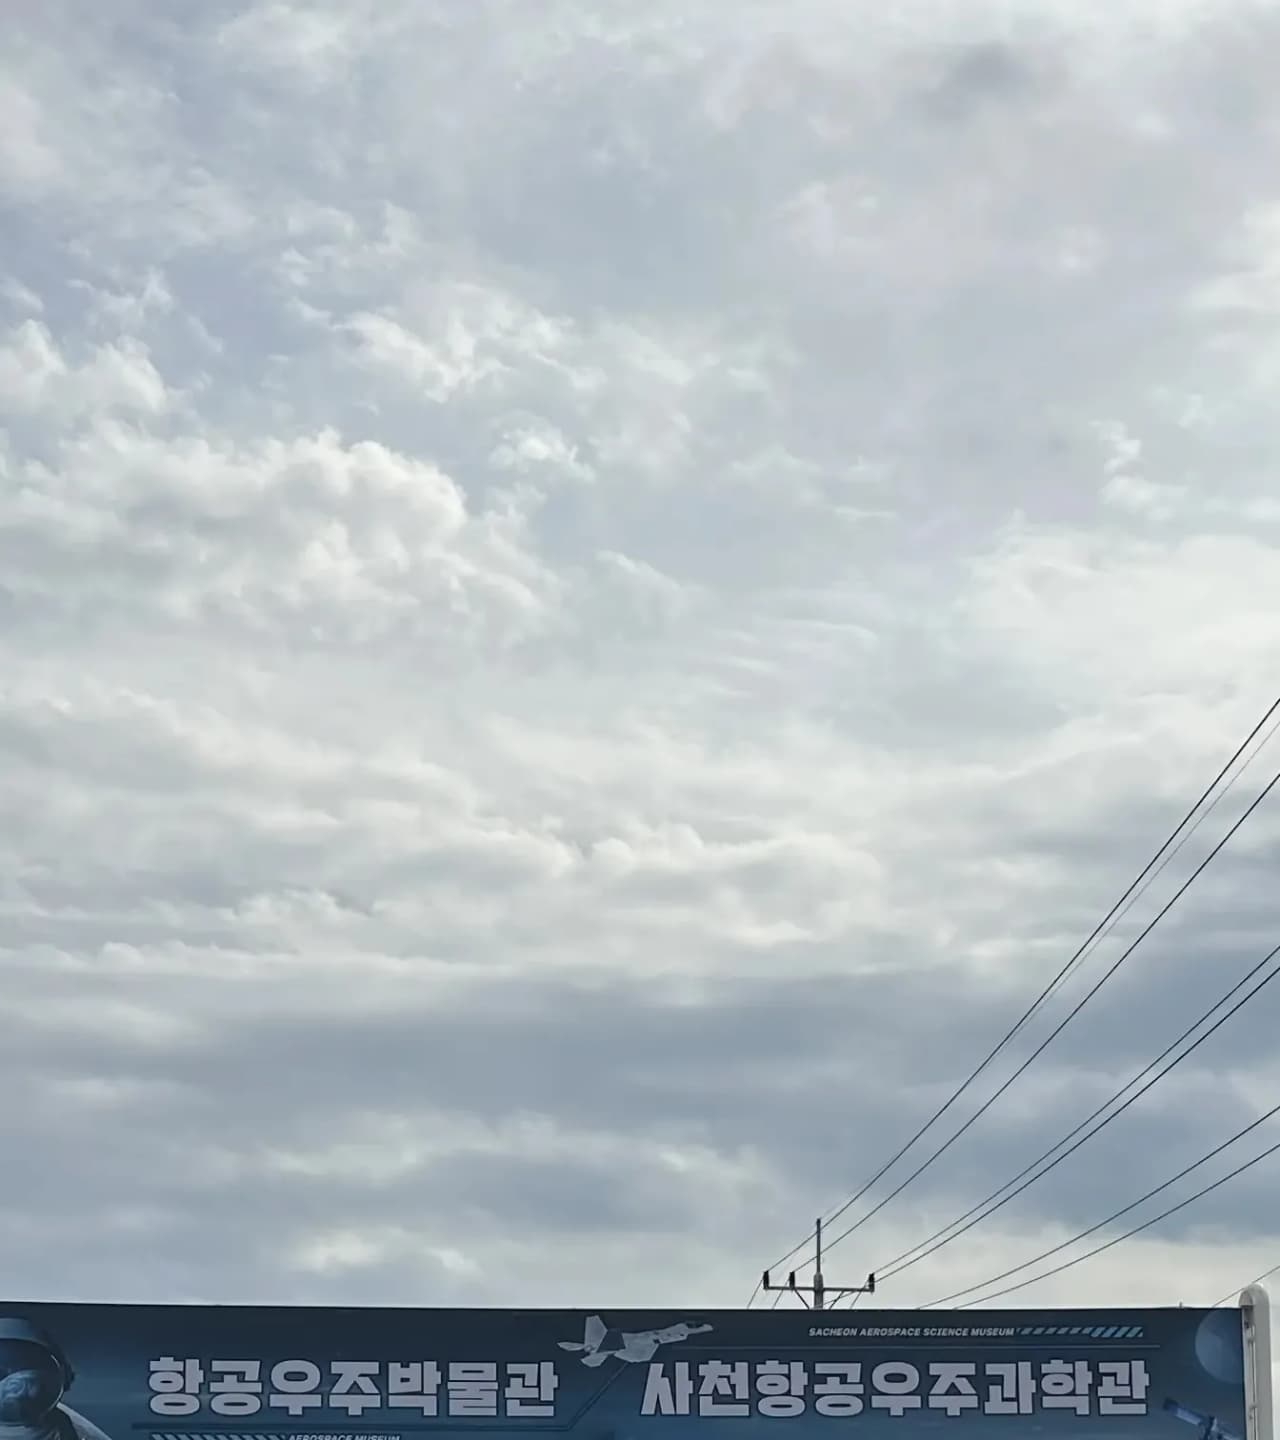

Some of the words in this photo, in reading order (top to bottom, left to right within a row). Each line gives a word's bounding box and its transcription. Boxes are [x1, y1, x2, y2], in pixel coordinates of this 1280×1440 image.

[808, 1327, 857, 1337] SACHEON
[859, 1327, 921, 1337] AEROSPACE
[923, 1327, 969, 1337] SCIENCE
[970, 1327, 1015, 1337] MUSEUM
[148, 1356, 559, 1417] 항공우주박물관
[640, 1359, 1151, 1417] 사천항공우주과학관
